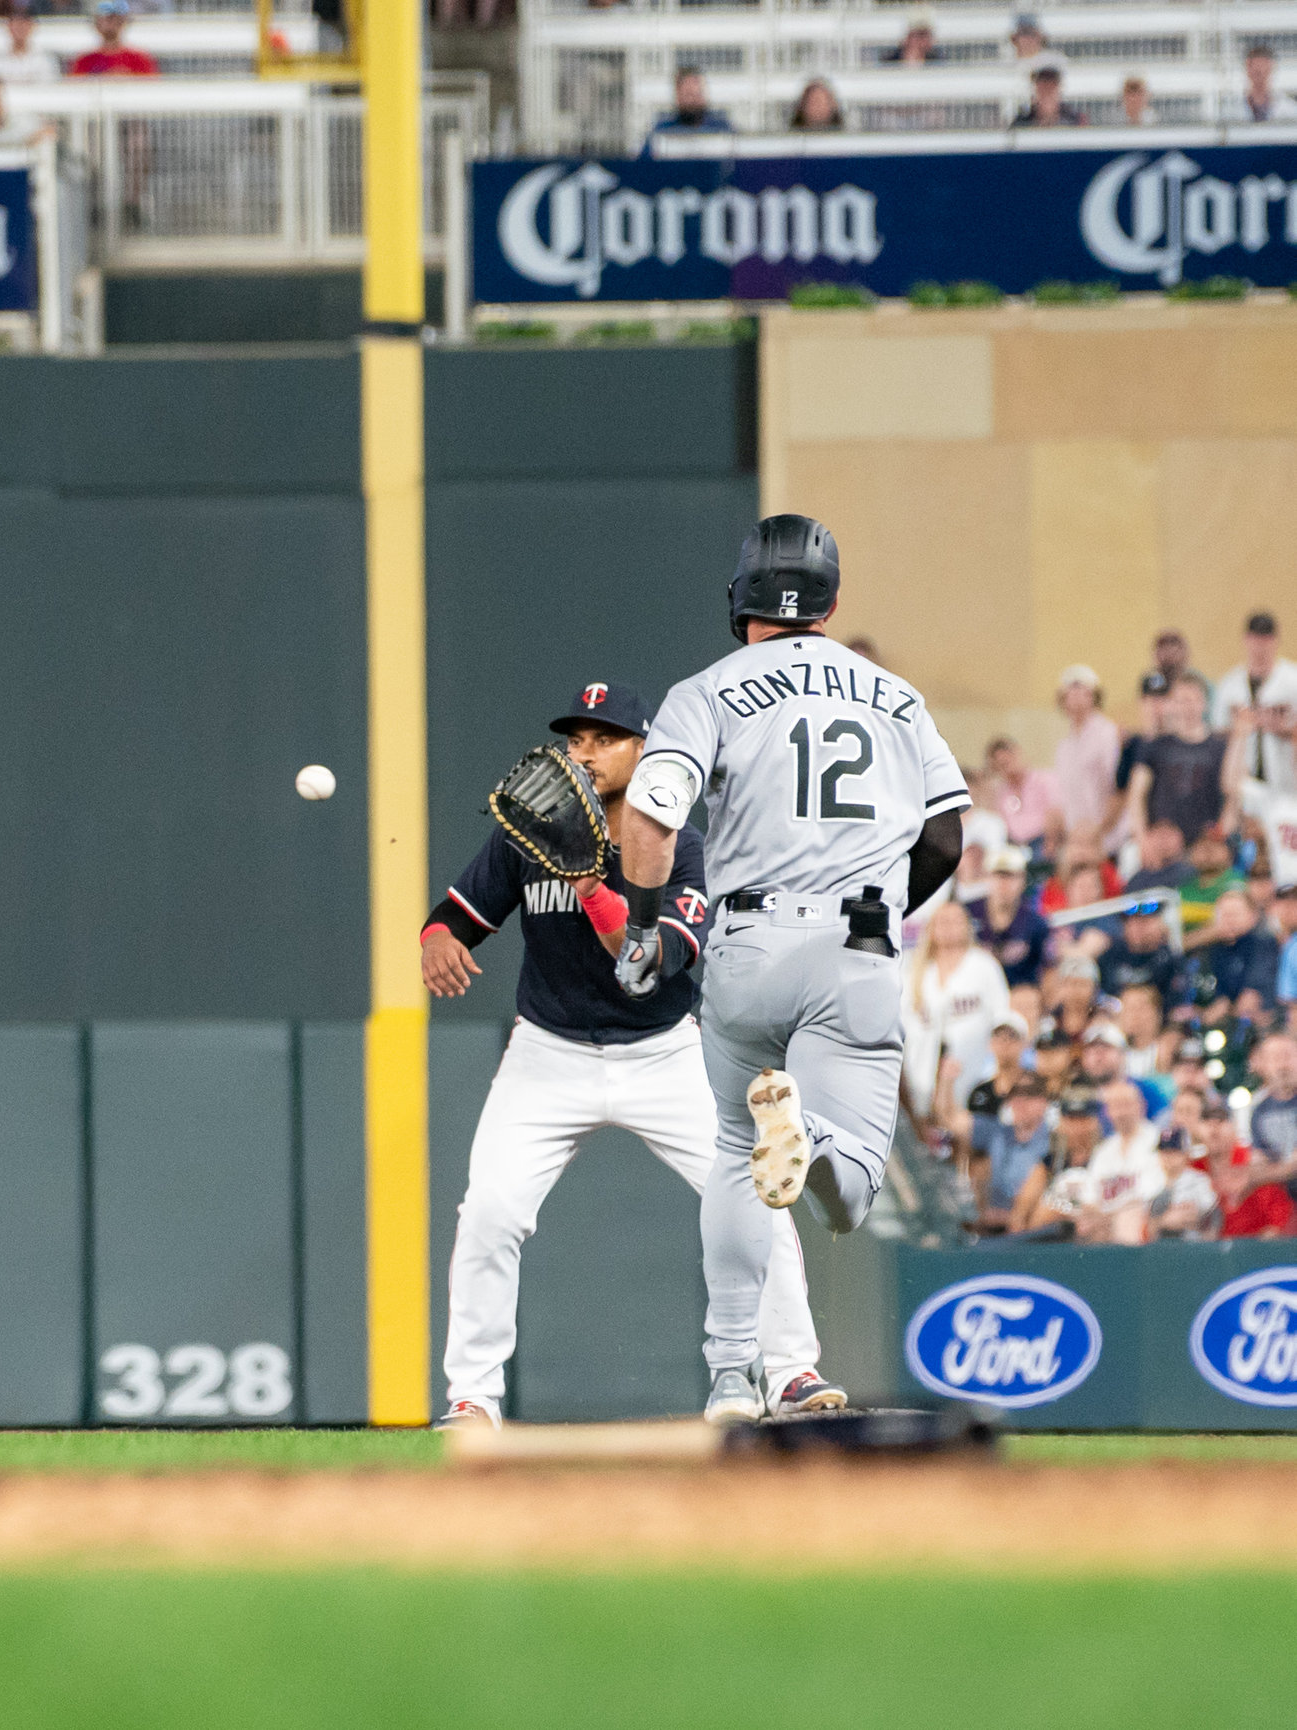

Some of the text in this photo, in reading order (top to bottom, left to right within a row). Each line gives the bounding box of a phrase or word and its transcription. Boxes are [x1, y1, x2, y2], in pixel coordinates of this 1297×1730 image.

[497, 150, 1297, 298] Corona Cor
[781, 590, 799, 607] 12
[717, 662, 917, 725] GONZALEZ
[787, 715, 877, 822] 12
[99, 1343, 294, 1417] 328
[942, 1292, 1065, 1386] Ford
[1226, 1286, 1297, 1384] Fo
